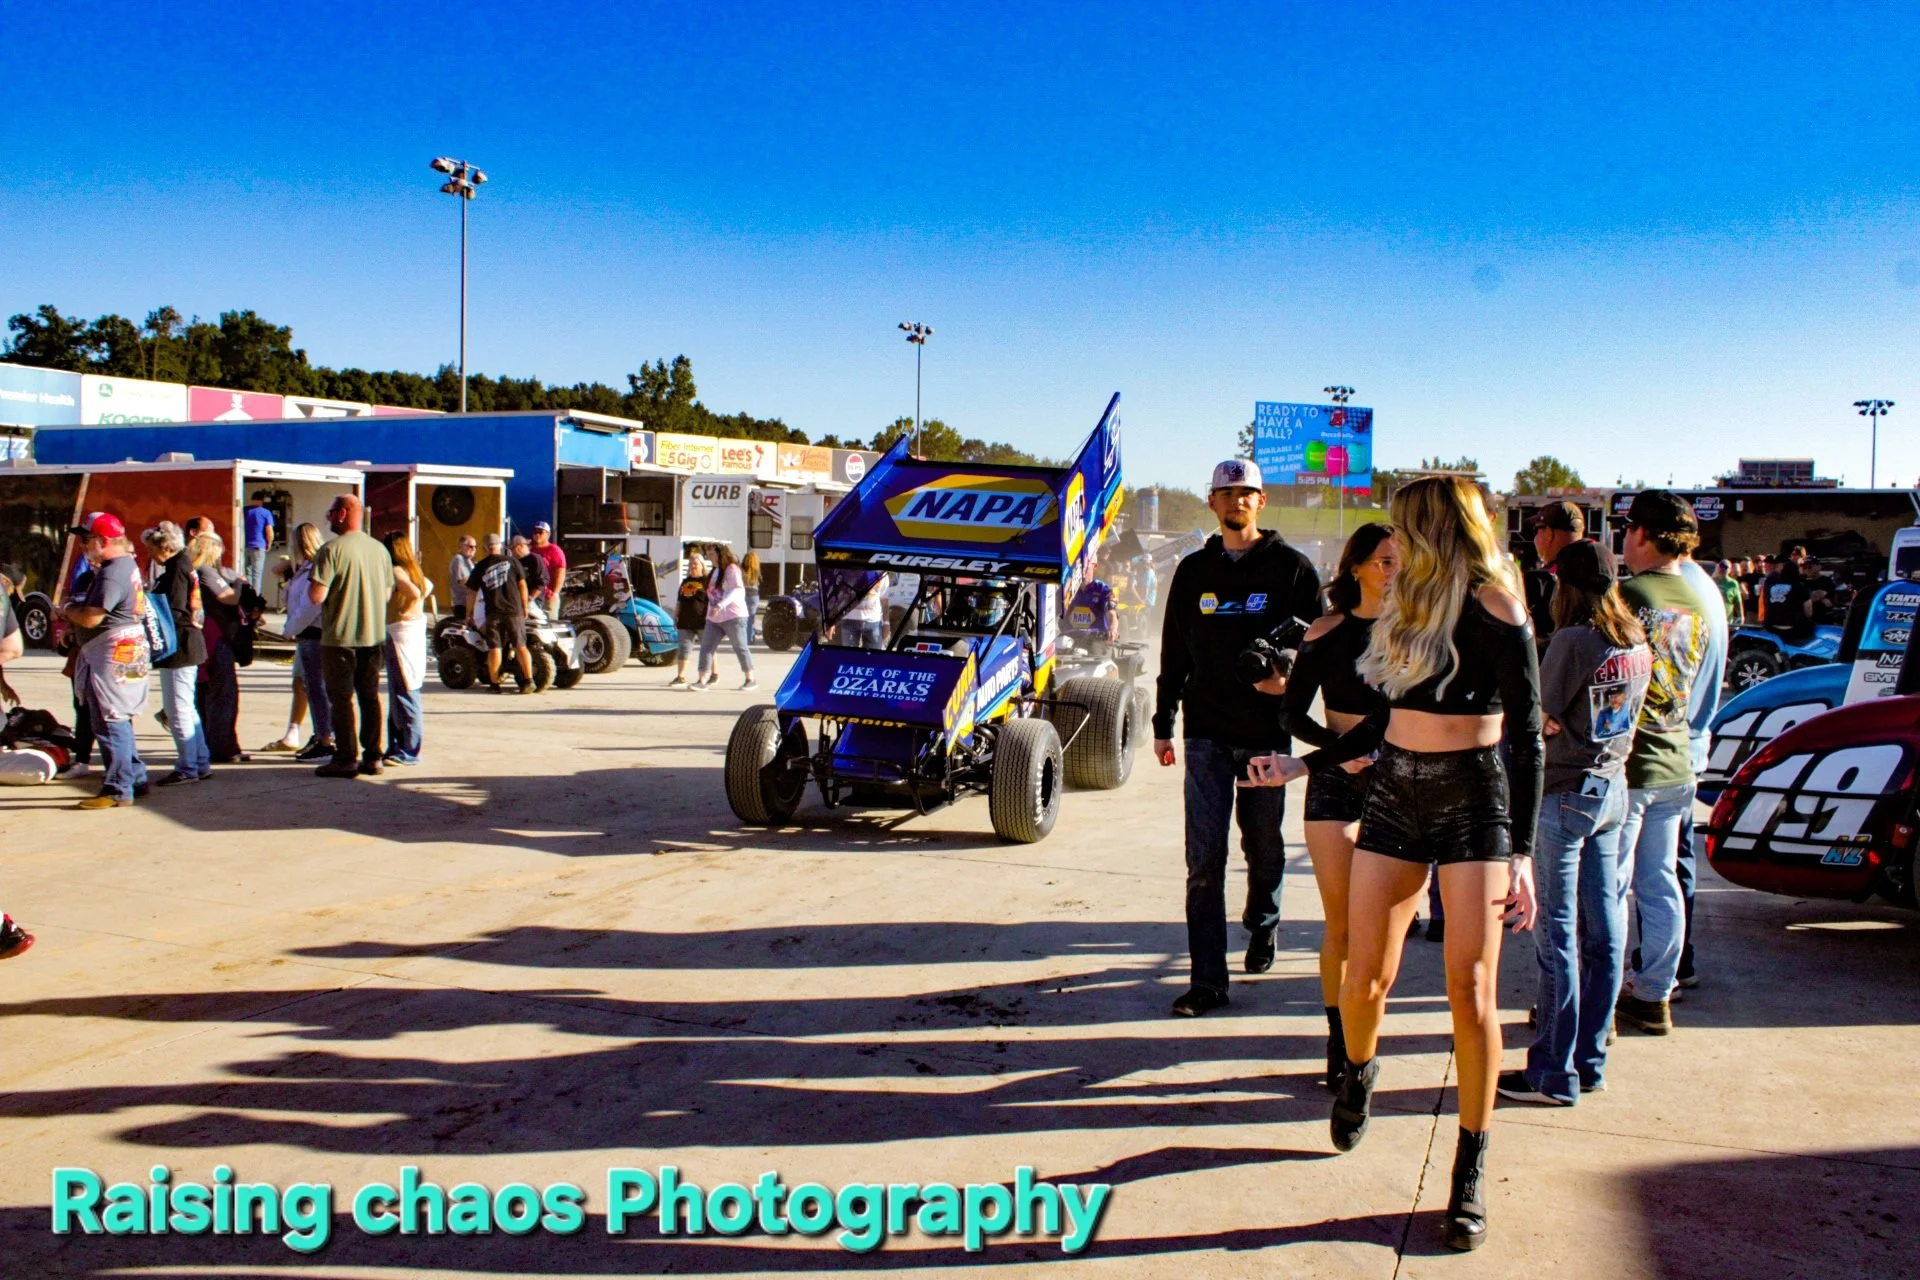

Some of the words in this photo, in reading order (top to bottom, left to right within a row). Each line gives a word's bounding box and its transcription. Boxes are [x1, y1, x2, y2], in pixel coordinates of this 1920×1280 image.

[38, 391, 75, 407] Health
[1258, 404, 1298, 417] READY
[1304, 406, 1319, 418] TO
[1258, 415, 1290, 428] HAVE
[1295, 418, 1303, 429] A
[1257, 426, 1293, 440] BALL?
[661, 440, 680, 451] Fiber
[684, 443, 714, 453] Internet
[668, 452, 676, 464] 5
[677, 452, 697, 470] Gig
[721, 448, 752, 462] Lee's
[721, 461, 752, 470] Famous
[1297, 476, 1316, 485] 5:25
[1316, 477, 1330, 485] PM
[691, 485, 742, 500] CURB
[907, 490, 1042, 525] NAPA
[868, 553, 1011, 573] PURSLEY
[1023, 566, 1059, 575] KSP
[1072, 612, 1090, 623] NAPA
[836, 664, 875, 677] LAKE
[881, 668, 901, 680] OF
[908, 671, 937, 683] THE
[996, 655, 1019, 694] PARTS
[832, 675, 931, 698] OZARKS
[1722, 744, 1904, 856] 19
